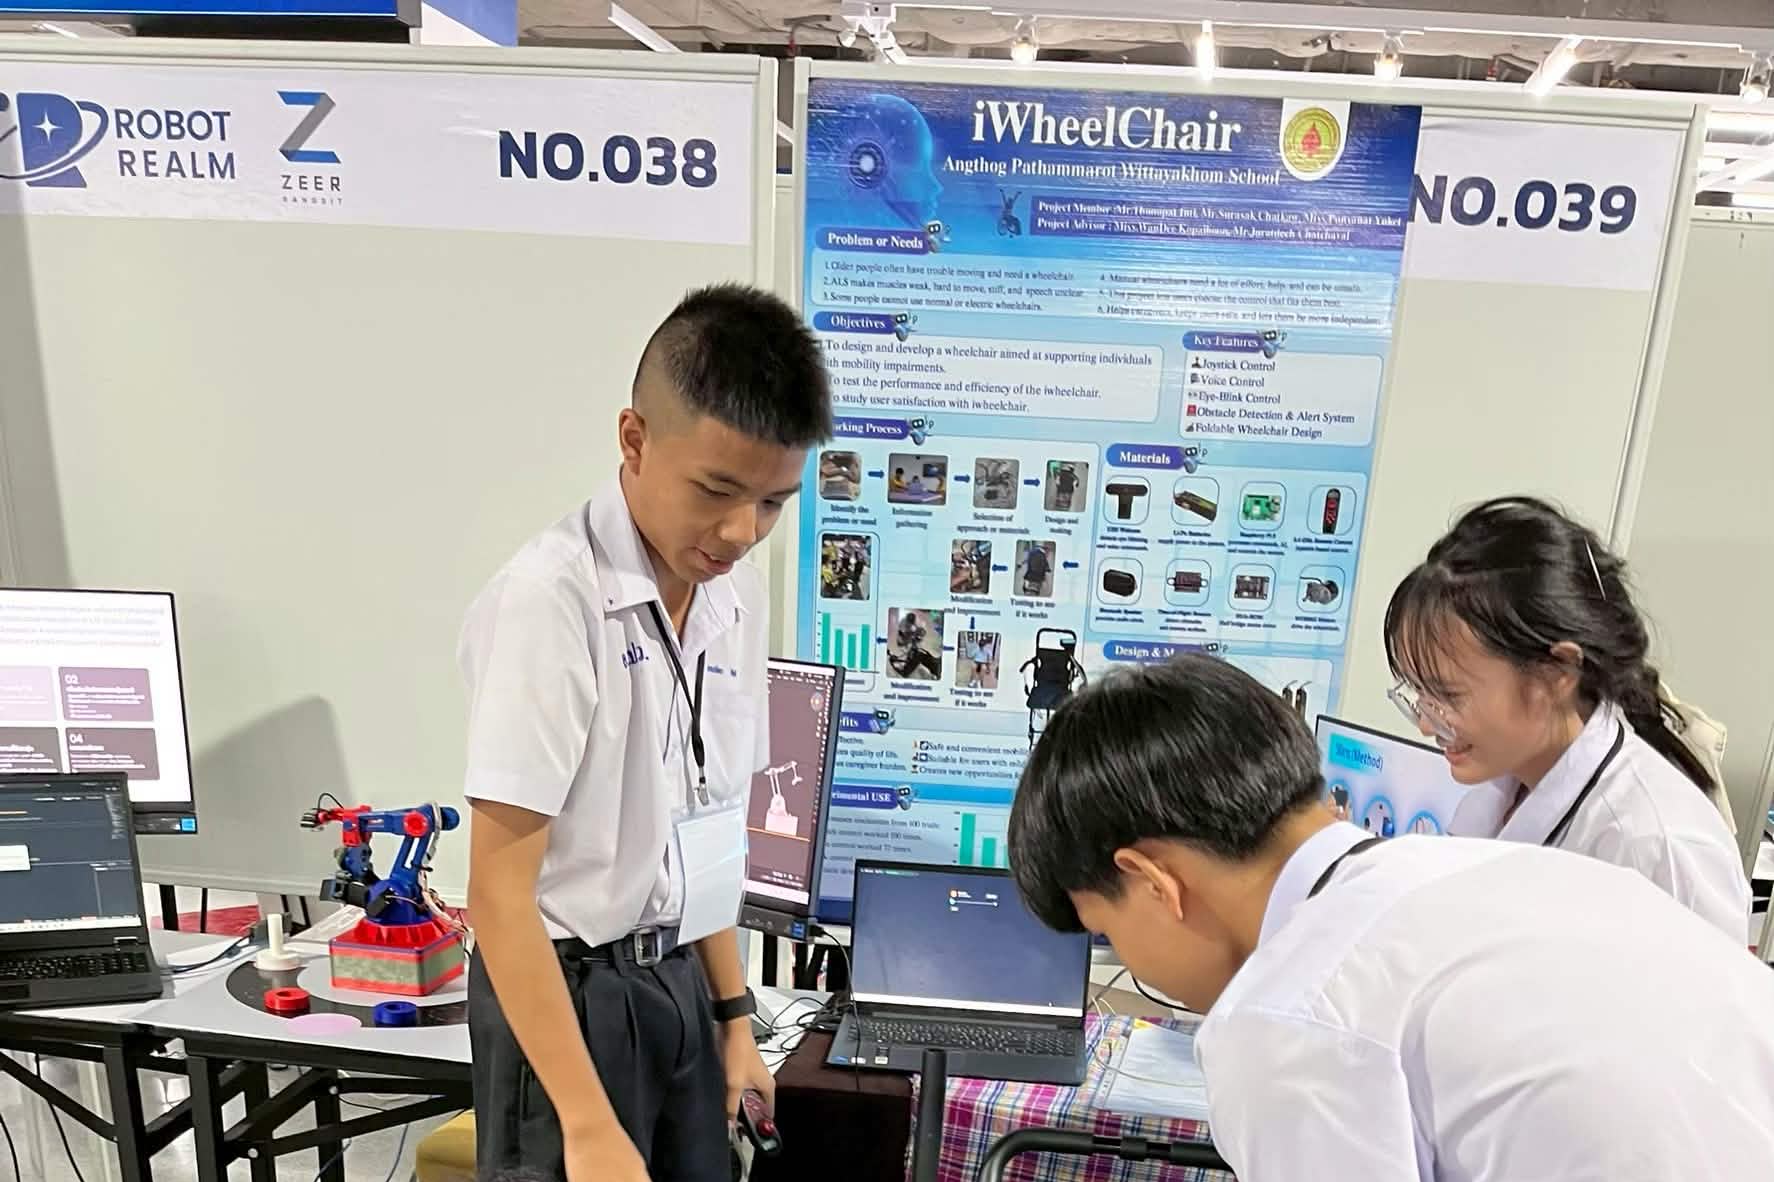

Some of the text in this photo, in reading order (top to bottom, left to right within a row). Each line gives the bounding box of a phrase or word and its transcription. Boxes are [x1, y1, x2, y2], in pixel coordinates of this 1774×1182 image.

[114, 108, 231, 141] ROBOT
[972, 100, 1241, 152] iWheelChair
[118, 149, 236, 180] REALM
[499, 130, 718, 188] NO.038
[943, 155, 1007, 177] Angthog
[1229, 168, 1280, 186] School
[281, 174, 342, 192] ZEER
[1039, 200, 1071, 214] Project
[1408, 174, 1637, 235] NO.039
[1038, 217, 1070, 231] Project
[828, 232, 923, 249] Problem or Needs
[987, 270, 1002, 278] and
[1004, 270, 1023, 279] need
[1007, 287, 1023, 295] and
[831, 316, 886, 330] Objectives
[1194, 335, 1214, 348] Key
[825, 339, 840, 351] To
[842, 342, 873, 354] design
[875, 343, 894, 354] and
[896, 344, 934, 357] develop
[945, 346, 997, 358] wheelchair
[1000, 348, 1030, 360] aimed
[1032, 350, 1042, 361] at
[1044, 351, 1097, 366] supporting
[1099, 352, 1152, 366] individuals
[826, 357, 946, 373] ith mobility impairments.
[1199, 359, 1276, 372] Joystick Control
[842, 376, 860, 386] test
[862, 376, 878, 387] the
[880, 378, 943, 391] performance
[944, 382, 962, 393] and
[965, 383, 1011, 397] efficiency
[1013, 383, 1024, 394] of
[1026, 384, 1041, 395] the
[1200, 374, 1265, 388] Voice Control
[842, 393, 867, 406] study
[870, 396, 889, 406] user
[893, 395, 946, 408] satisfaction
[948, 398, 970, 409] with
[1198, 390, 1281, 404] Eye-Blink Control
[1197, 406, 1355, 425] Obstacle Detection & Alert System
[866, 423, 902, 434] Process
[1195, 422, 1323, 440] Foldable Wheelchair Design
[1119, 450, 1171, 465] Materials
[1115, 644, 1149, 659] Design
[1151, 647, 1160, 657] &
[832, 791, 892, 803] erimental USE
